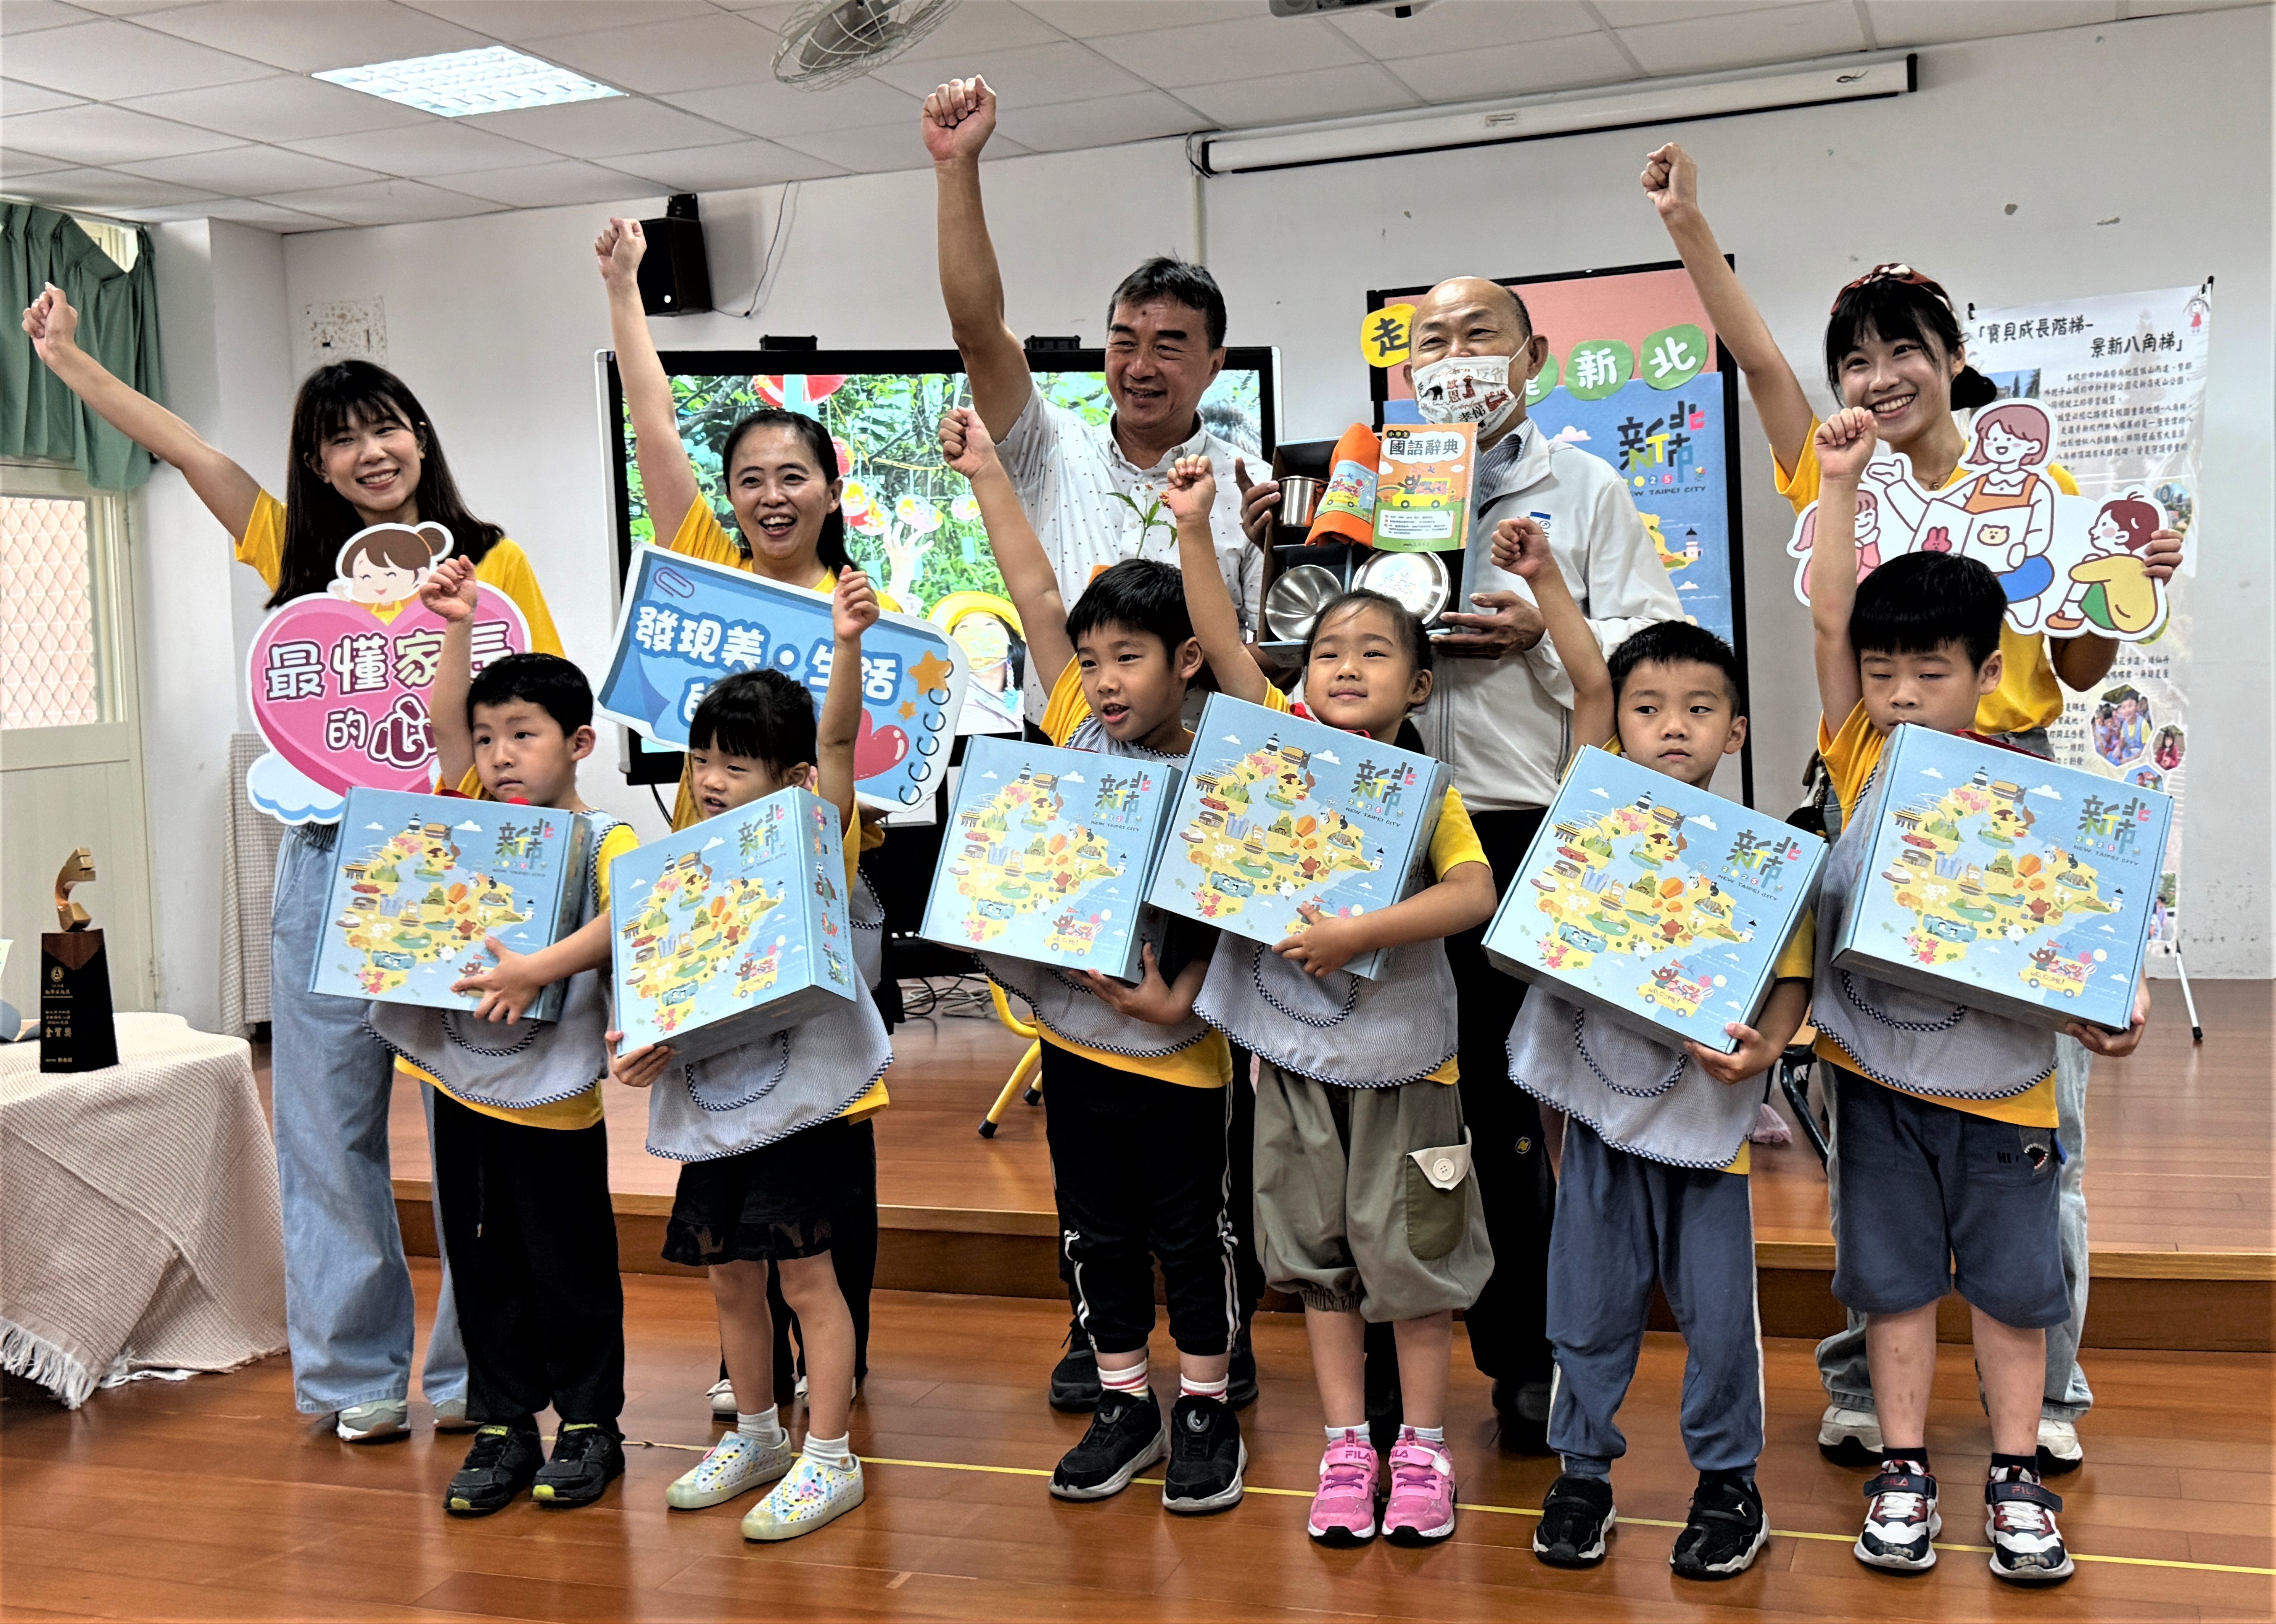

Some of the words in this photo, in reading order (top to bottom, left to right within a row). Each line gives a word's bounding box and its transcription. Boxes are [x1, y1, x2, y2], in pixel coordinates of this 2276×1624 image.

[1371, 317, 1409, 356] 走
[1389, 439, 1458, 456] 國語辭典
[1364, 813, 1384, 822] TAIPEI
[1345, 1450, 1372, 1462] FILA
[1391, 1449, 1409, 1458] ILA
[1882, 1478, 1909, 1487] FILA
[2011, 1485, 2042, 1496] FILA
